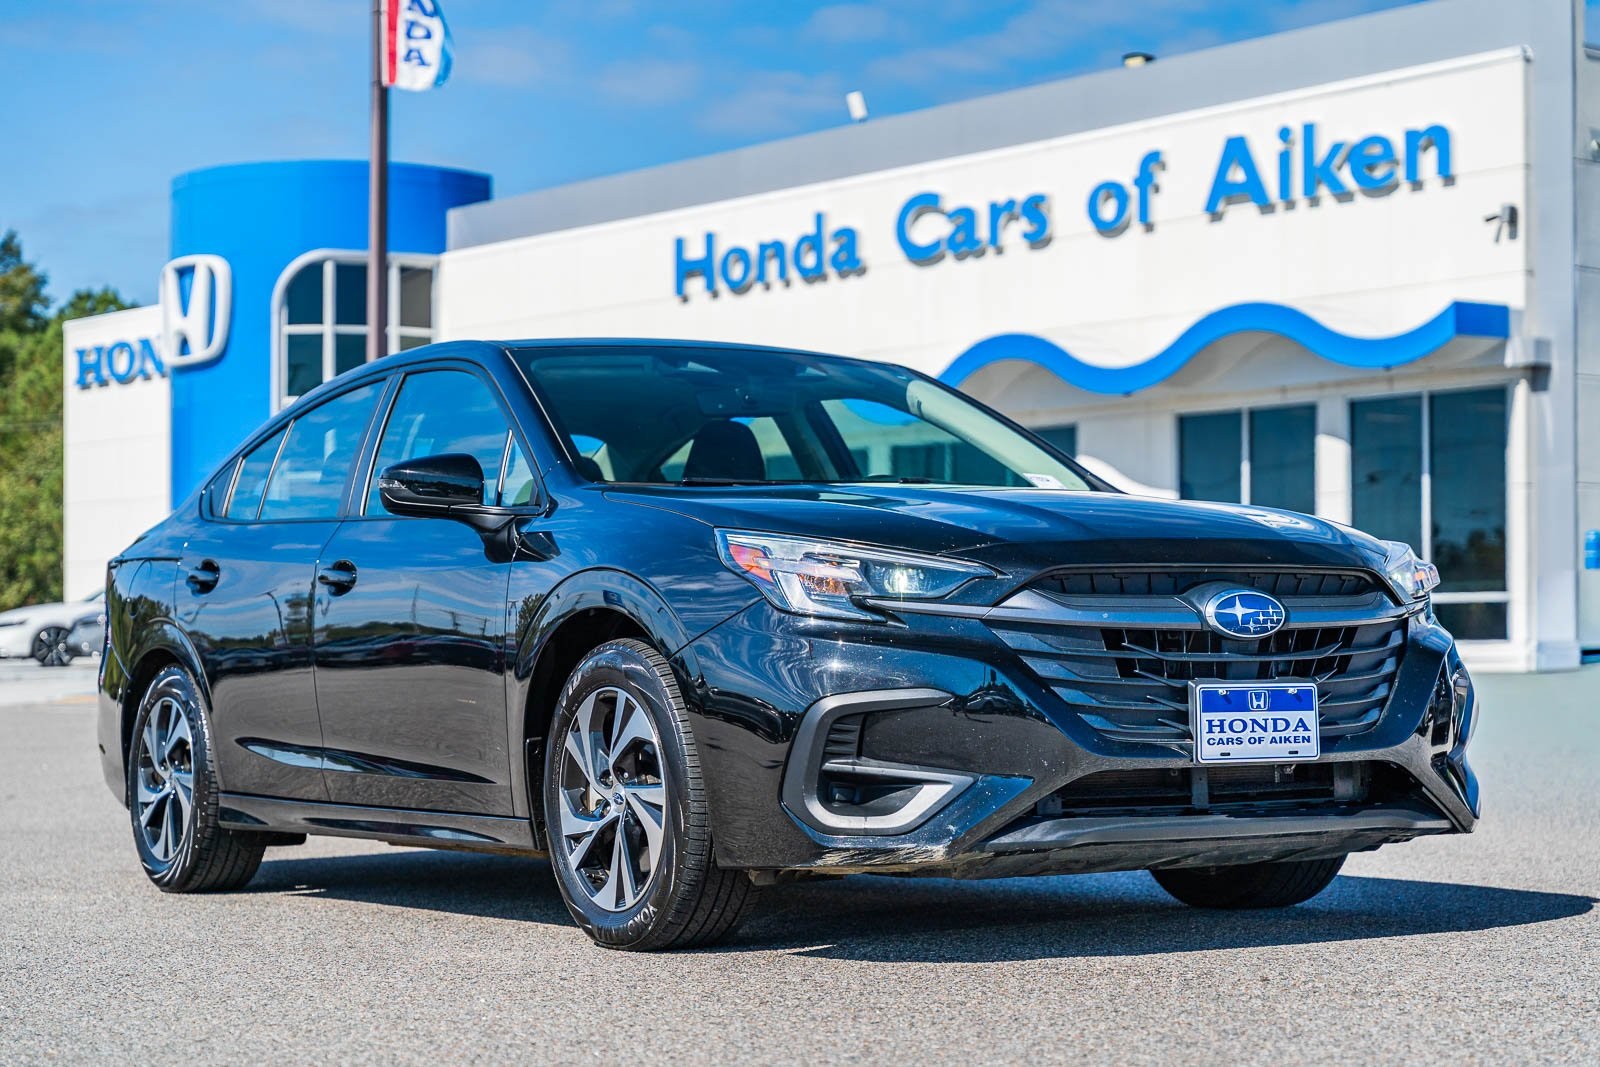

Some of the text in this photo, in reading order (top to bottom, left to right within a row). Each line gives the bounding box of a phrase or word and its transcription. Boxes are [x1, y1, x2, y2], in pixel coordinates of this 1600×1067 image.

[675, 122, 1452, 299] Honda Cars of Aiken
[1206, 717, 1312, 734] HONDA
[1207, 735, 1311, 746] CARS OF AIKEN
